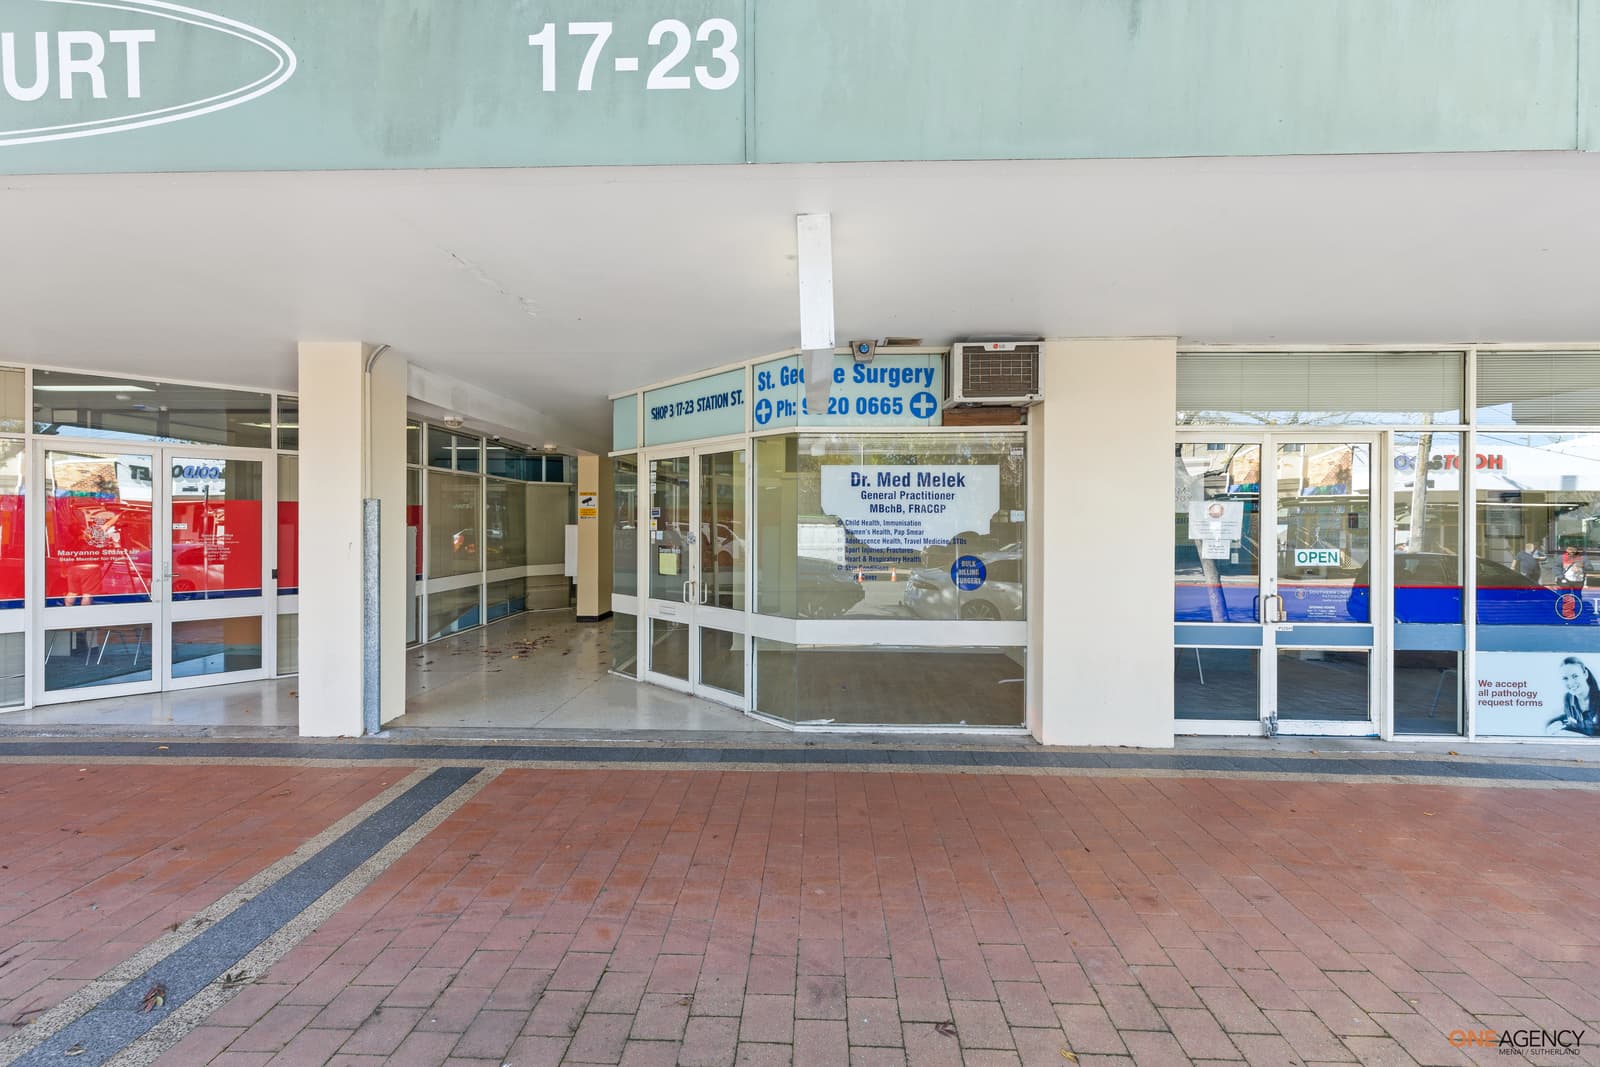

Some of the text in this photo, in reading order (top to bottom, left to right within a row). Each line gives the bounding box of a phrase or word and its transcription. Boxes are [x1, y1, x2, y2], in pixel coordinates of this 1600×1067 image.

[528, 18, 740, 92] 17-23
[757, 363, 935, 391] St. Geoe Surgery
[651, 389, 744, 420] SHOP 3 17-23 STATION ST.
[776, 396, 903, 417] Ph: 920 0665
[850, 471, 966, 487] Dr. Med Melek
[860, 490, 955, 500] General Practitioner
[869, 504, 946, 514] MBchB, FRACGP
[845, 519, 922, 528] Child Health, Immunisation
[872, 528, 892, 537] Health,
[893, 529, 905, 537] Pap
[906, 528, 924, 536] Smear
[882, 538, 903, 546] Health,
[923, 538, 951, 546] Medicine,
[1297, 551, 1338, 563] OPEN
[1478, 680, 1527, 689] We accept
[1478, 689, 1538, 699] all pathology
[1478, 699, 1543, 708] request forms
